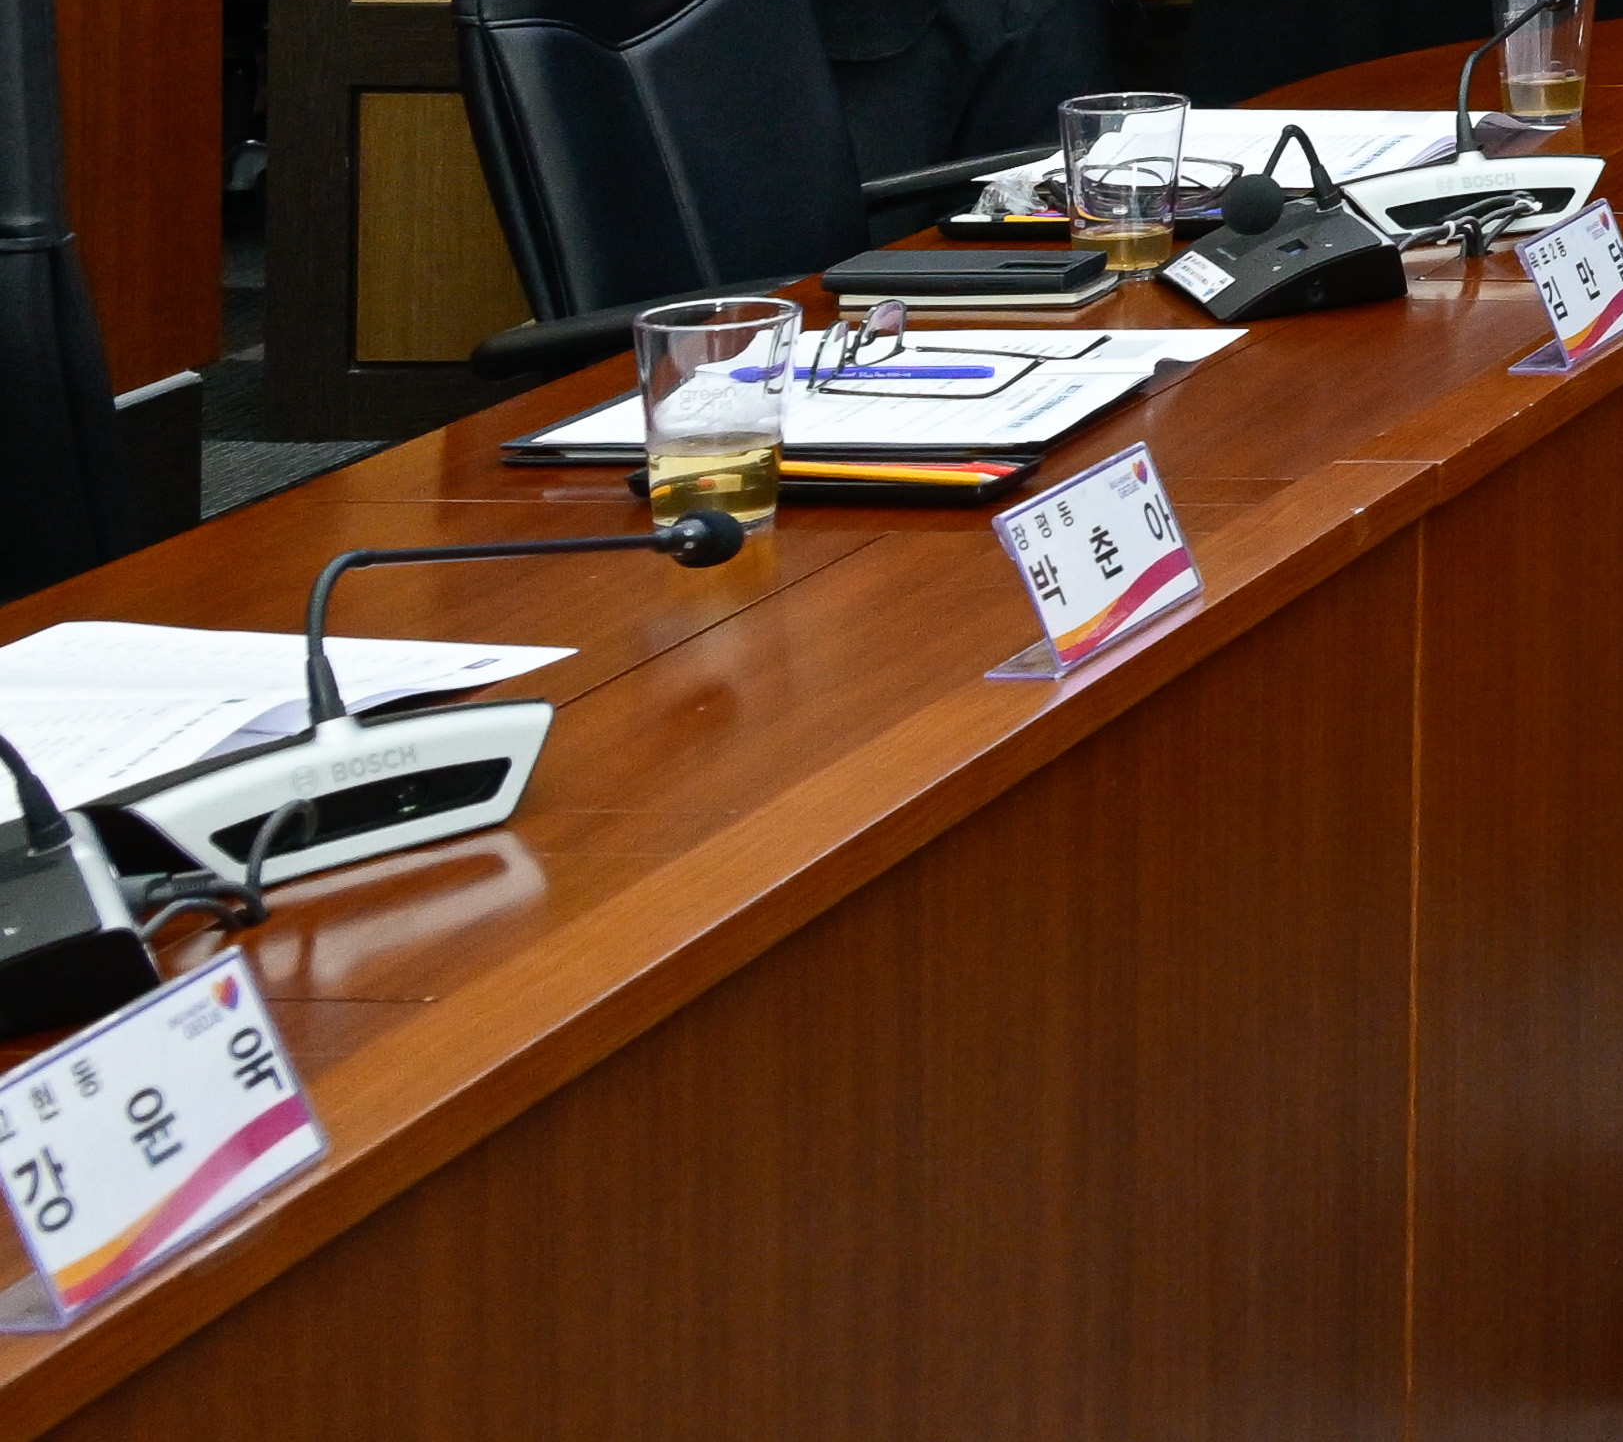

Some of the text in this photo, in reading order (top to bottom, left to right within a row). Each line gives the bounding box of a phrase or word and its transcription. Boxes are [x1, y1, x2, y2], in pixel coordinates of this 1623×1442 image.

[1462, 172, 1516, 189] BOSCH
[1028, 493, 1177, 607] 박춘아
[331, 743, 417, 783] BOSCH
[12, 1025, 285, 1234] 강윤욱
